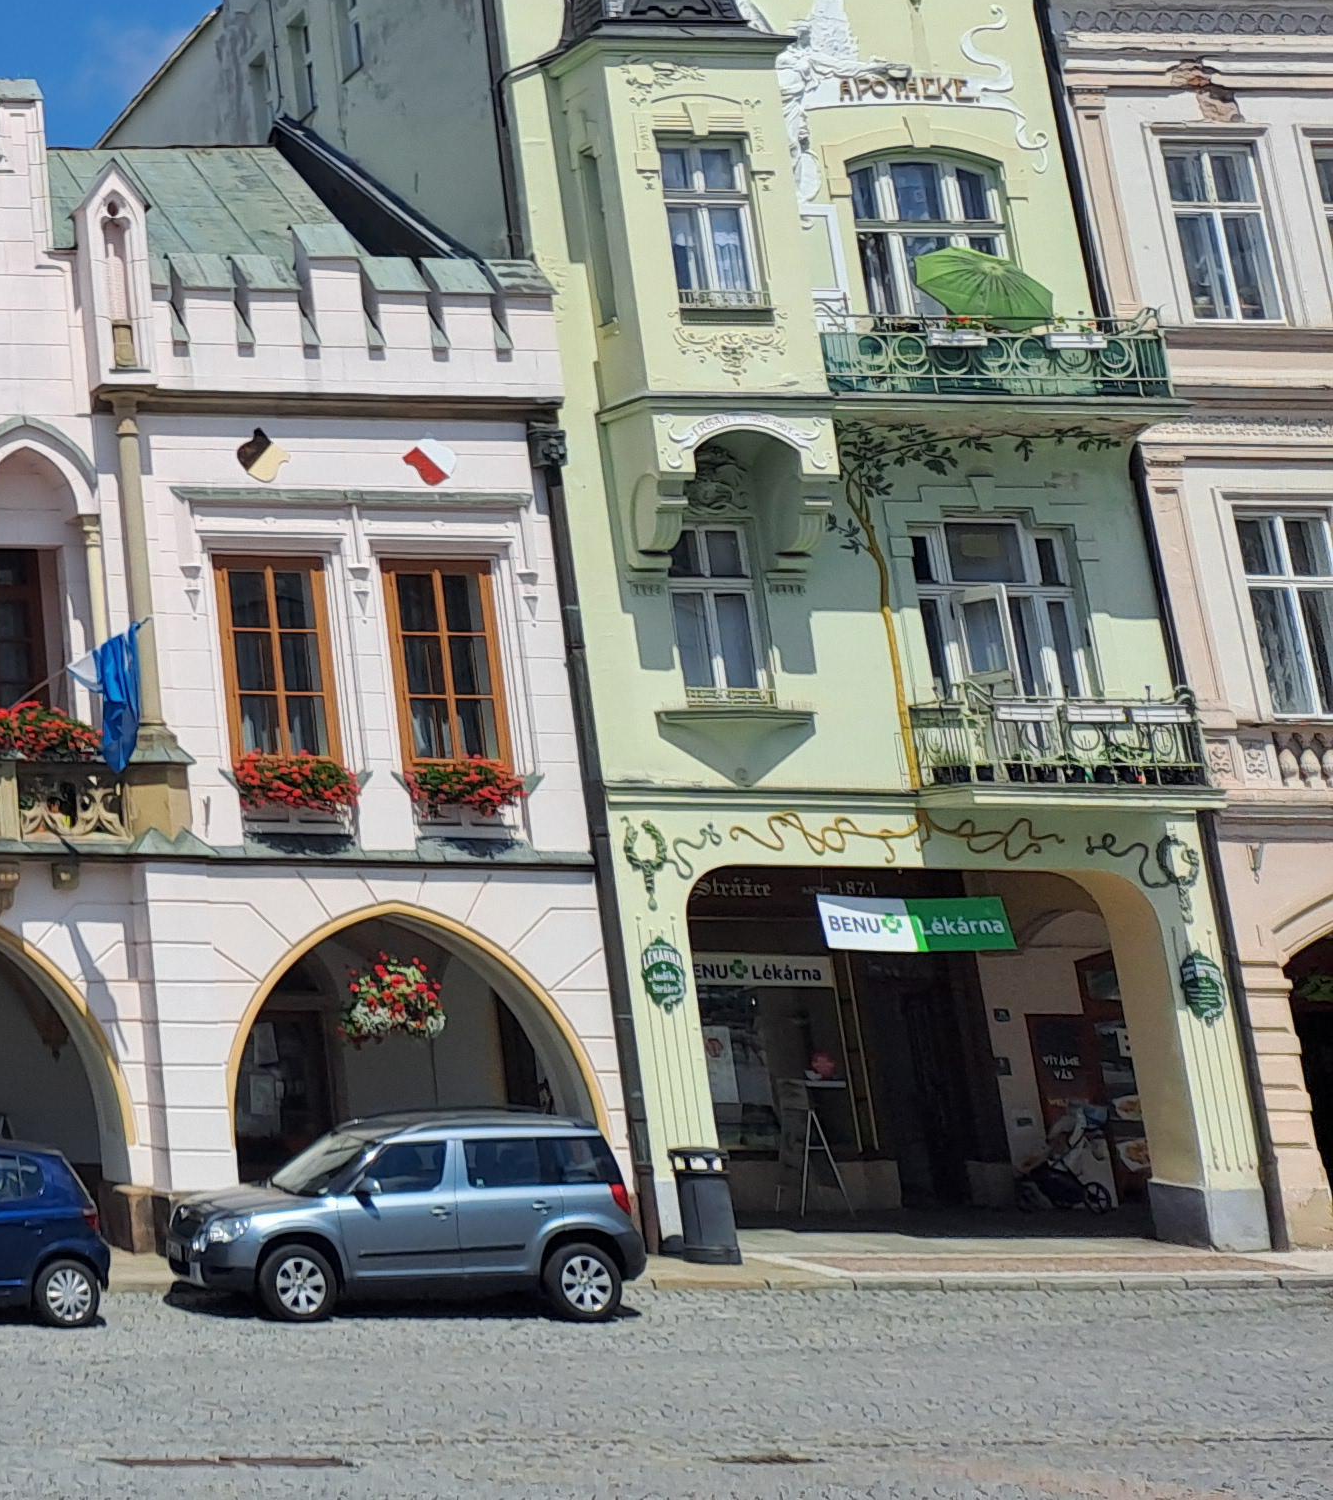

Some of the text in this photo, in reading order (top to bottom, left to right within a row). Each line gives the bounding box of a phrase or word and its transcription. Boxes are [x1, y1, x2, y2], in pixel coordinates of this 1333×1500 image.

[828, 915, 1005, 935] BENU Lékárna
[693, 961, 821, 980] ENU Lékárna
